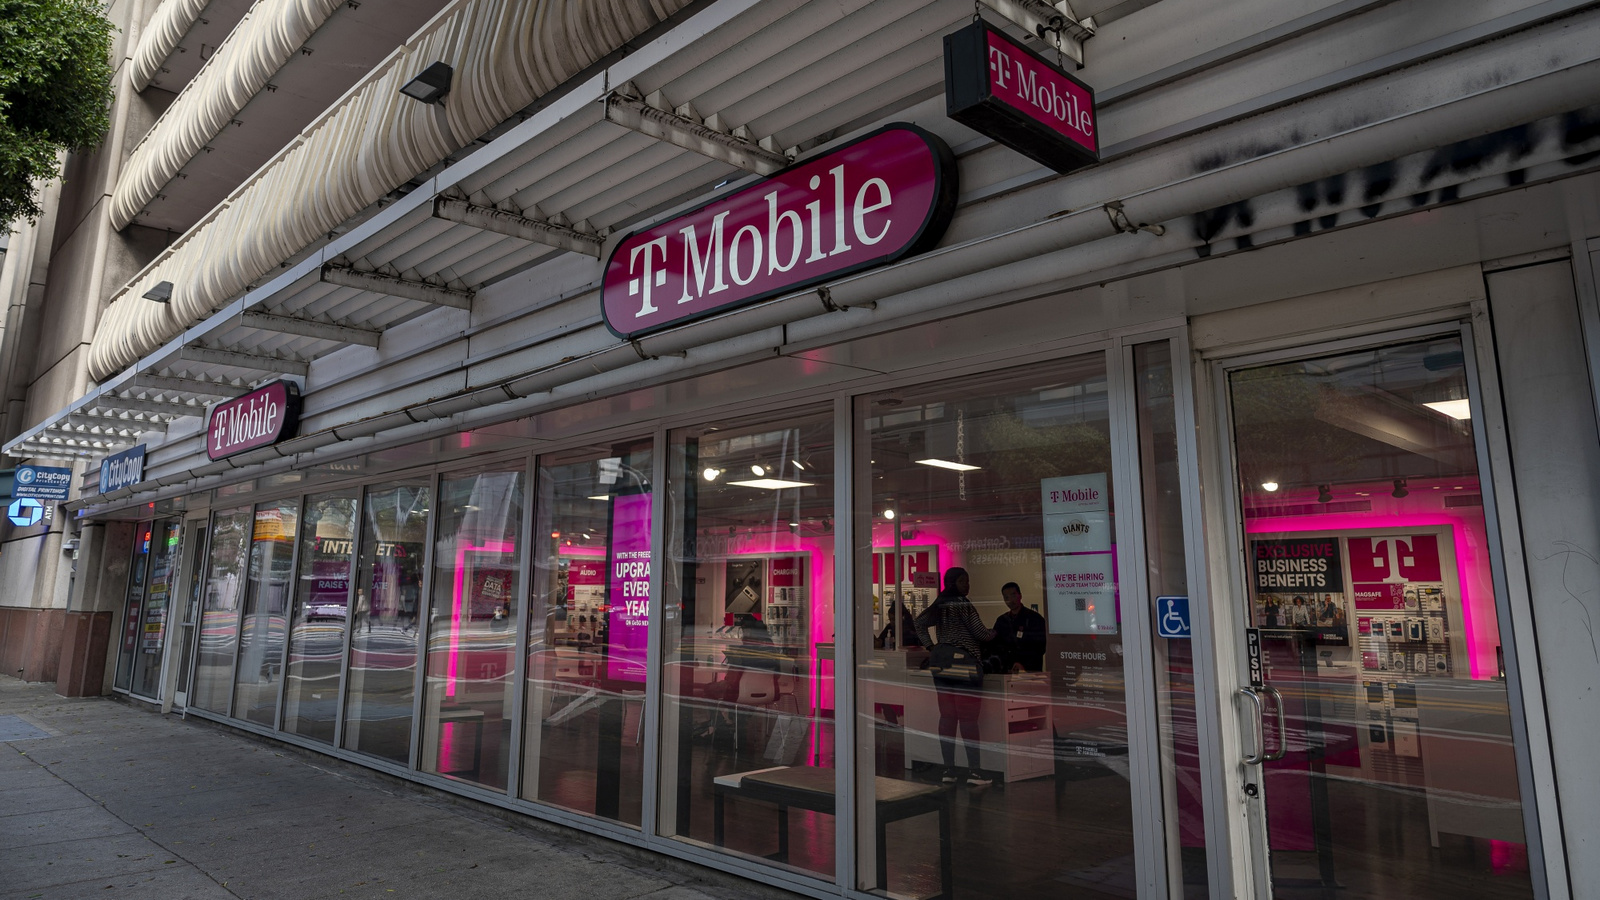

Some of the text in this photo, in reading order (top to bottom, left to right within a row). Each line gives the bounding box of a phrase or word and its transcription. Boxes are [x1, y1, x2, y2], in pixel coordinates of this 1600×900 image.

[1015, 60, 1092, 137] Mobile
[677, 164, 893, 305] Mobile
[226, 392, 277, 447] Mobile
[36, 471, 71, 482] CityCopy
[109, 455, 143, 490] CityCopy
[1062, 487, 1099, 502] Mobile
[45, 505, 53, 520] ATM
[1063, 523, 1090, 535] GIANTS
[323, 540, 395, 556] INTEET
[629, 551, 637, 559] THE
[1257, 543, 1334, 559] EXCLUSIVE
[616, 561, 651, 578] UPGRA
[773, 568, 798, 576] CHARGING
[1257, 558, 1327, 573] BUSINESS
[318, 580, 343, 589] RAISE
[1054, 572, 1104, 582] WE'RE HIRING
[1258, 573, 1326, 587] BENEFITS
[484, 580, 501, 592] DATA
[623, 581, 650, 597] EVER
[1060, 651, 1107, 661] STORE HOURS
[1248, 633, 1260, 682] PUSH
